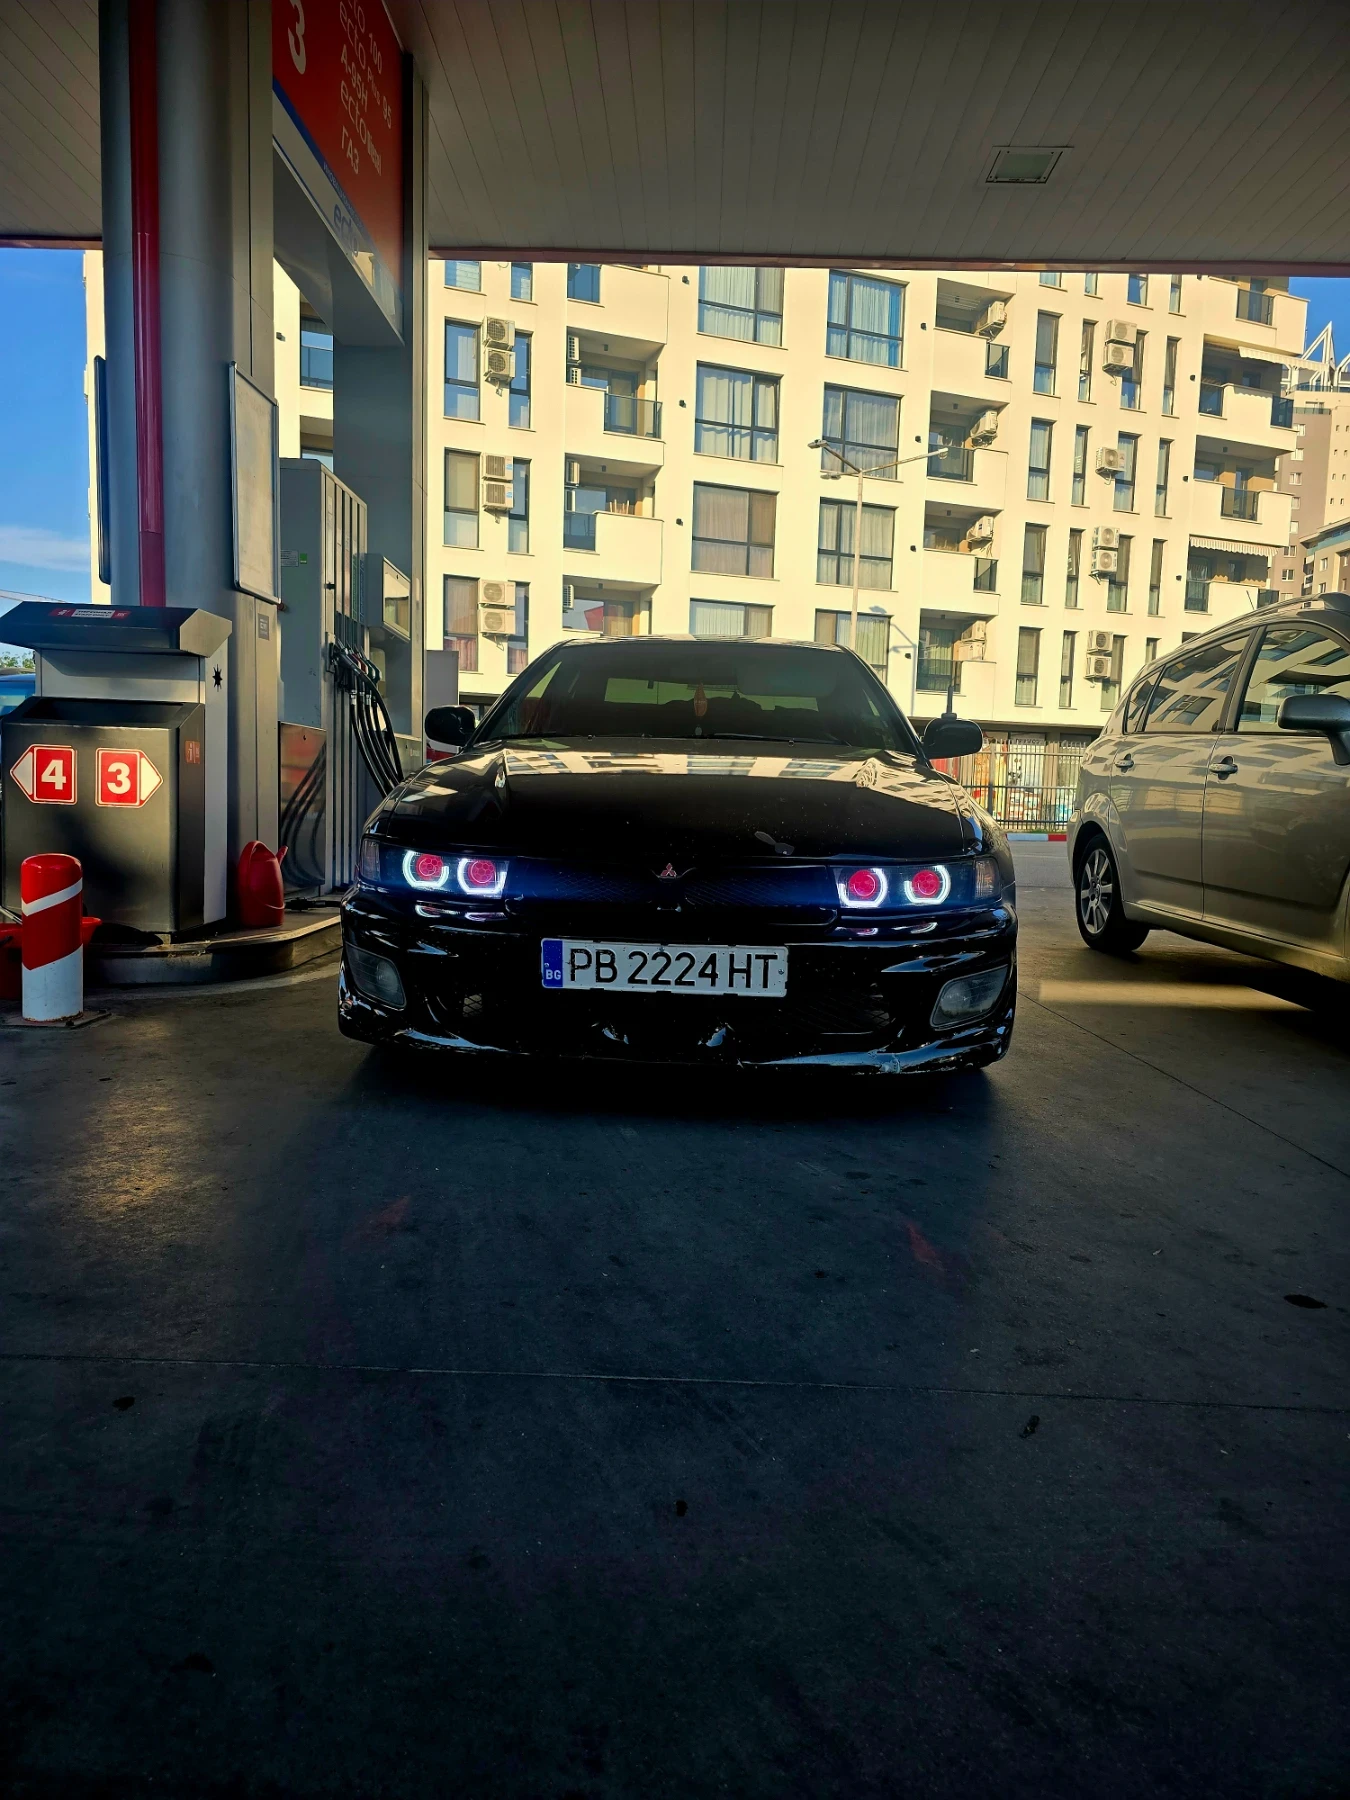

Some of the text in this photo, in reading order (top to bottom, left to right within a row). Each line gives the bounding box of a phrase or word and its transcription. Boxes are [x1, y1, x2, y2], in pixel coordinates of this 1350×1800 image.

[288, 0, 306, 75] 3
[369, 33, 382, 75] 100
[340, 0, 366, 70] ecto
[383, 96, 392, 129] 95
[41, 759, 67, 790] 4
[106, 762, 132, 795] 3
[545, 969, 562, 980] BG
[569, 948, 778, 989] PB 2224 HT
